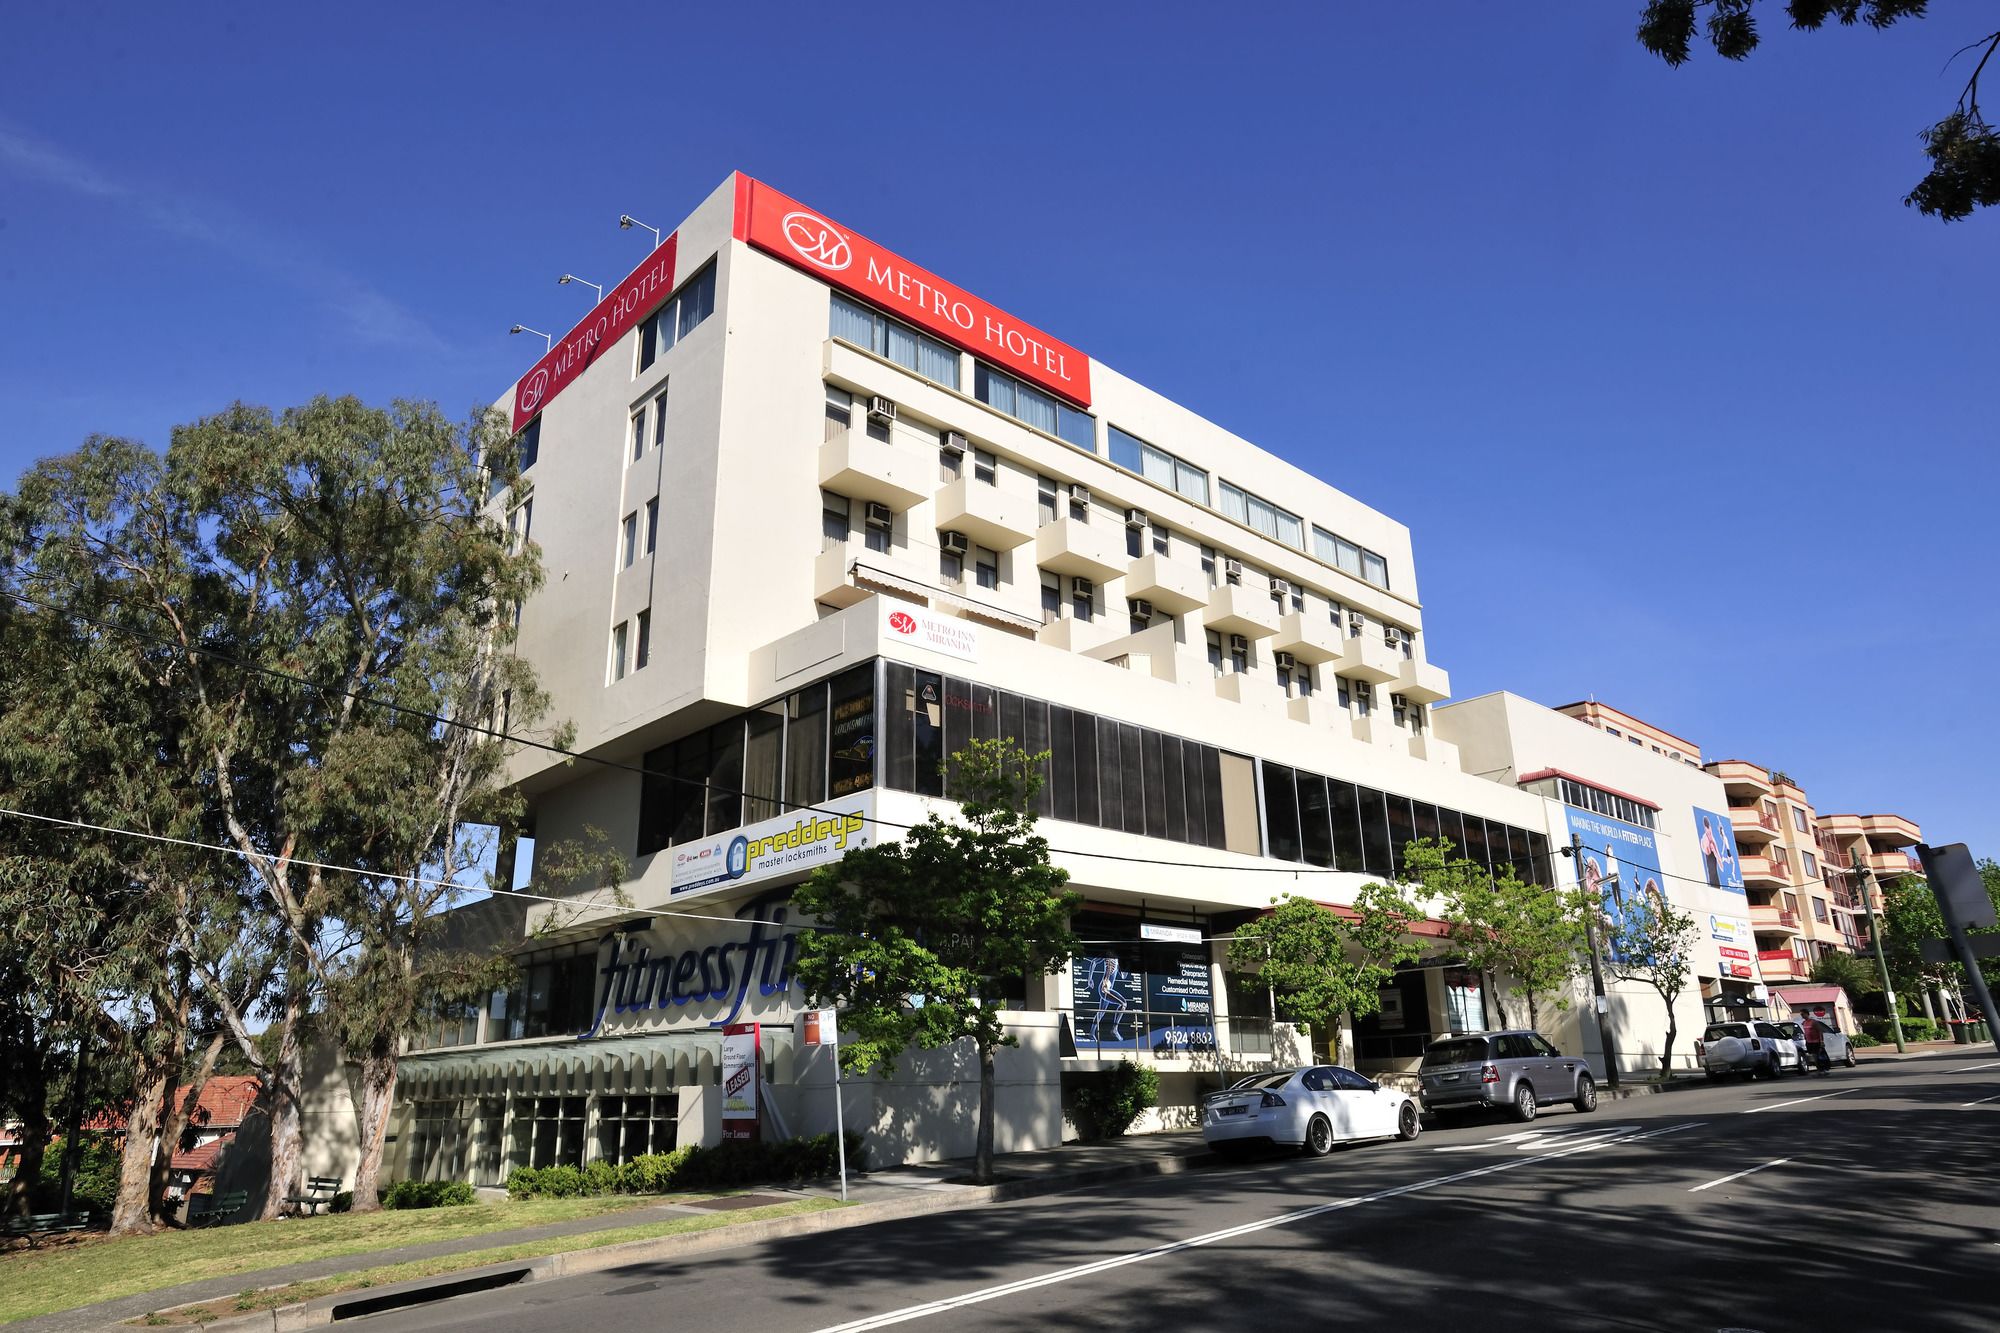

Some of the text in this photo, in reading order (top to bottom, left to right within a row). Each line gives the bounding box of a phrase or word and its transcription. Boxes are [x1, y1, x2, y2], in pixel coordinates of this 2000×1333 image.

[554, 260, 668, 382] METRO HOTEL
[866, 256, 1071, 381] METRO HOTEL
[922, 619, 976, 643] METRO INN
[927, 632, 971, 652] MIRANDA
[746, 810, 864, 872] preddeys
[1571, 815, 1591, 832] MAKING
[1591, 820, 1600, 834] THE
[1600, 823, 1618, 839] WORLD
[1622, 829, 1639, 844] FITTER
[1639, 834, 1654, 848] PLACE
[758, 845, 828, 870] master locksmiths
[1167, 976, 1208, 987] Remedial Massage
[1182, 969, 1207, 978] Chiropractic
[1162, 985, 1209, 995] Customised Orthotics
[1187, 1001, 1209, 1010] MIRANDA
[1165, 1031, 1213, 1044] 9524 8862
[723, 1046, 734, 1054] Large
[726, 1071, 749, 1094] LEASED
[722, 1129, 750, 1139] For Lease
